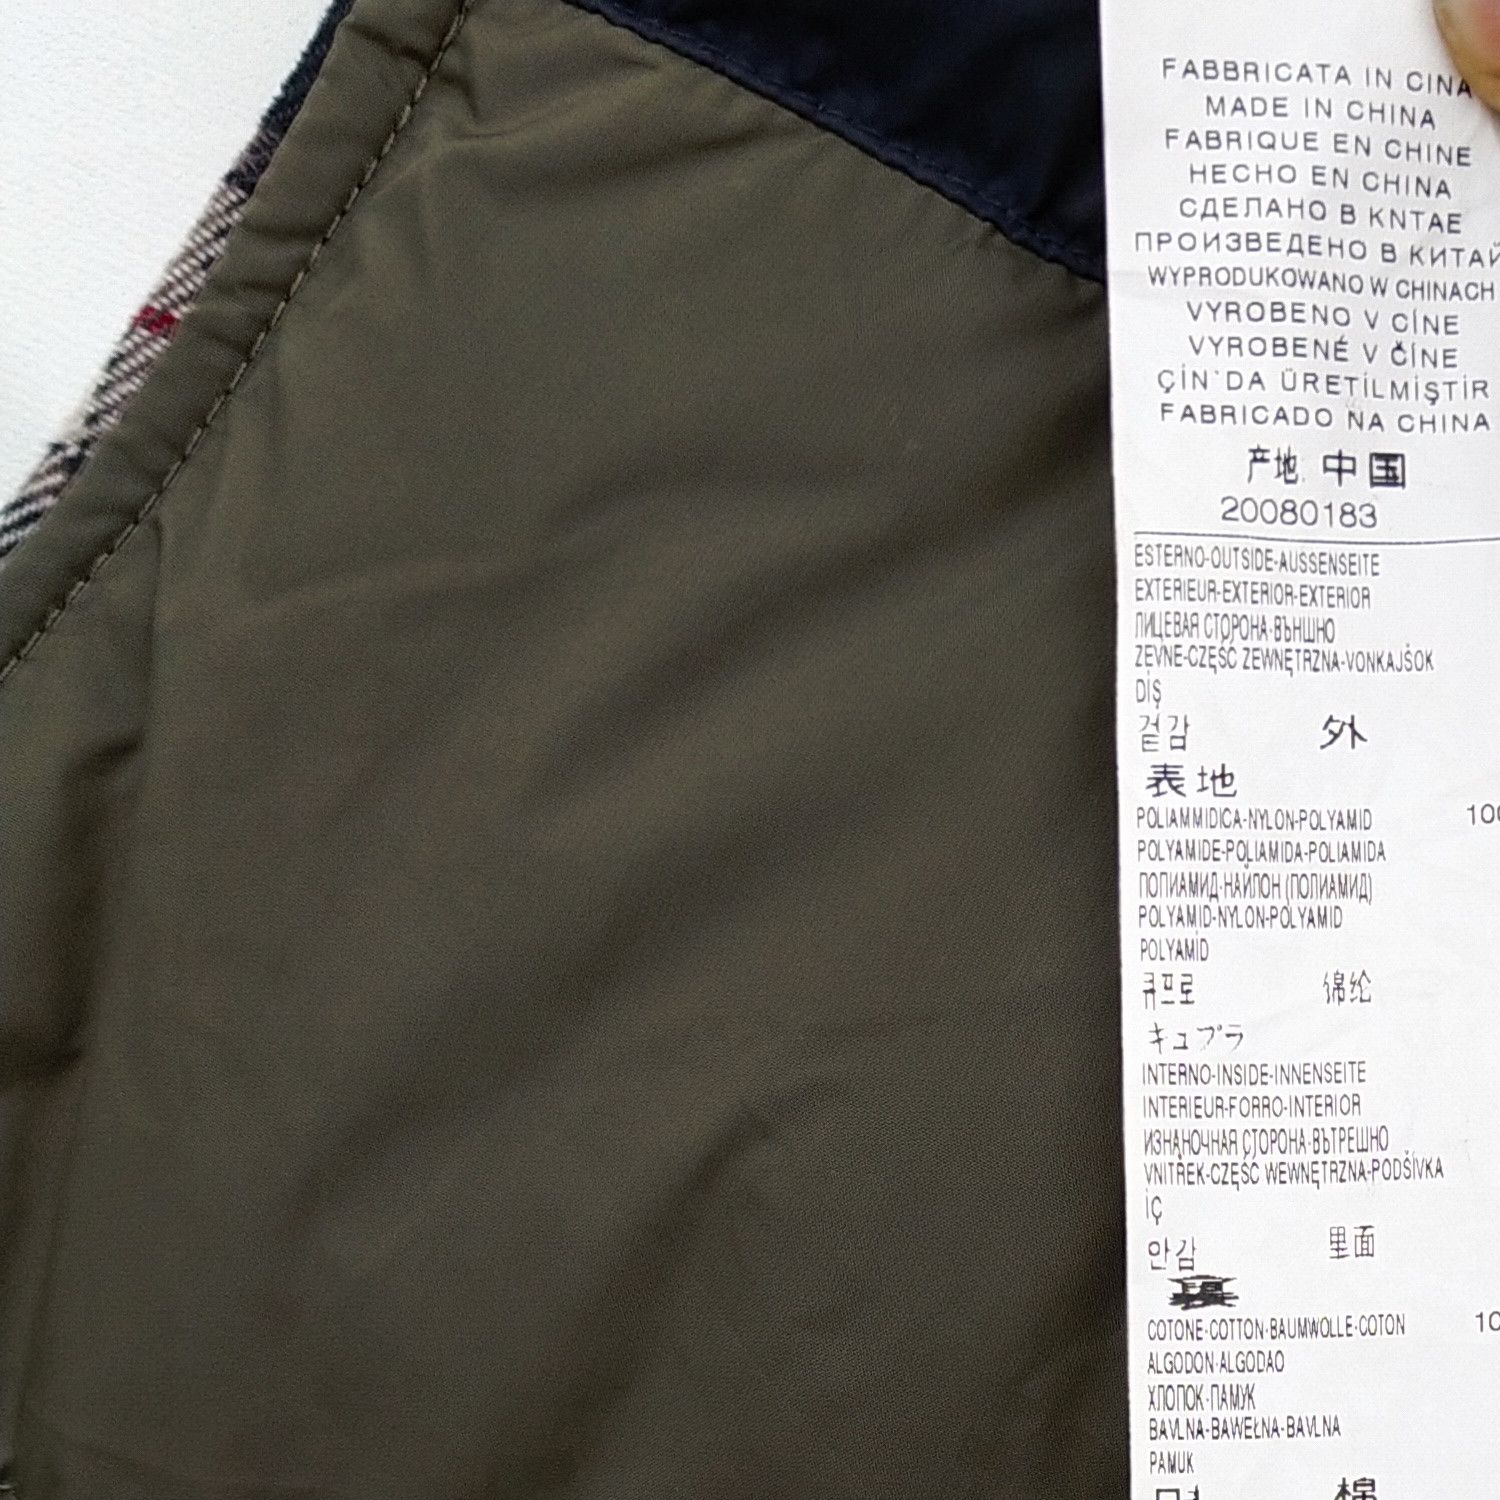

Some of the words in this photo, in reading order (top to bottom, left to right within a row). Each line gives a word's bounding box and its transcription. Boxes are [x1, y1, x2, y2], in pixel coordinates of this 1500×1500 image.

[1162, 57, 1352, 86] FABBRICATA
[1365, 66, 1393, 89] IN
[1405, 70, 1474, 99] CINA
[1205, 95, 1289, 118] MADE
[1304, 97, 1333, 120] IN
[1346, 99, 1436, 131] CHINA
[1164, 127, 1320, 153] FABRIQUE
[1333, 132, 1372, 158] EN
[1384, 138, 1472, 168] CHINE
[1189, 162, 1297, 185] HECHO
[1311, 165, 1349, 189] EN
[1361, 171, 1452, 200] CHINA
[1134, 231, 1368, 261] ПРОИЗВЕДЕНО
[1147, 265, 1364, 296] WYPRODUKOWANO
[1369, 275, 1390, 299] W
[1395, 277, 1495, 303] CHINACH
[1186, 300, 1352, 327] VYROBENO
[1363, 308, 1380, 331] V
[1188, 333, 1350, 363] VYROBENÉ
[1362, 343, 1379, 365] V
[1390, 339, 1459, 370] ČÍNE
[1280, 366, 1490, 407] ÜRETİLMİŞTİR
[1160, 402, 1334, 428] FABRICADO
[1347, 408, 1385, 433] NA
[1397, 412, 1491, 434] CHINA
[1246, 444, 1300, 485] 产地
[1322, 448, 1406, 489] 中国
[1220, 494, 1378, 530] 20080183
[1319, 713, 1369, 751] 外
[1144, 762, 1238, 799] 表地
[1147, 1021, 1244, 1054] キュプラ
[1147, 1236, 1198, 1272] 안감
[1328, 1224, 1376, 1260] 里面
[1149, 1450, 1195, 1475] PAMUK
